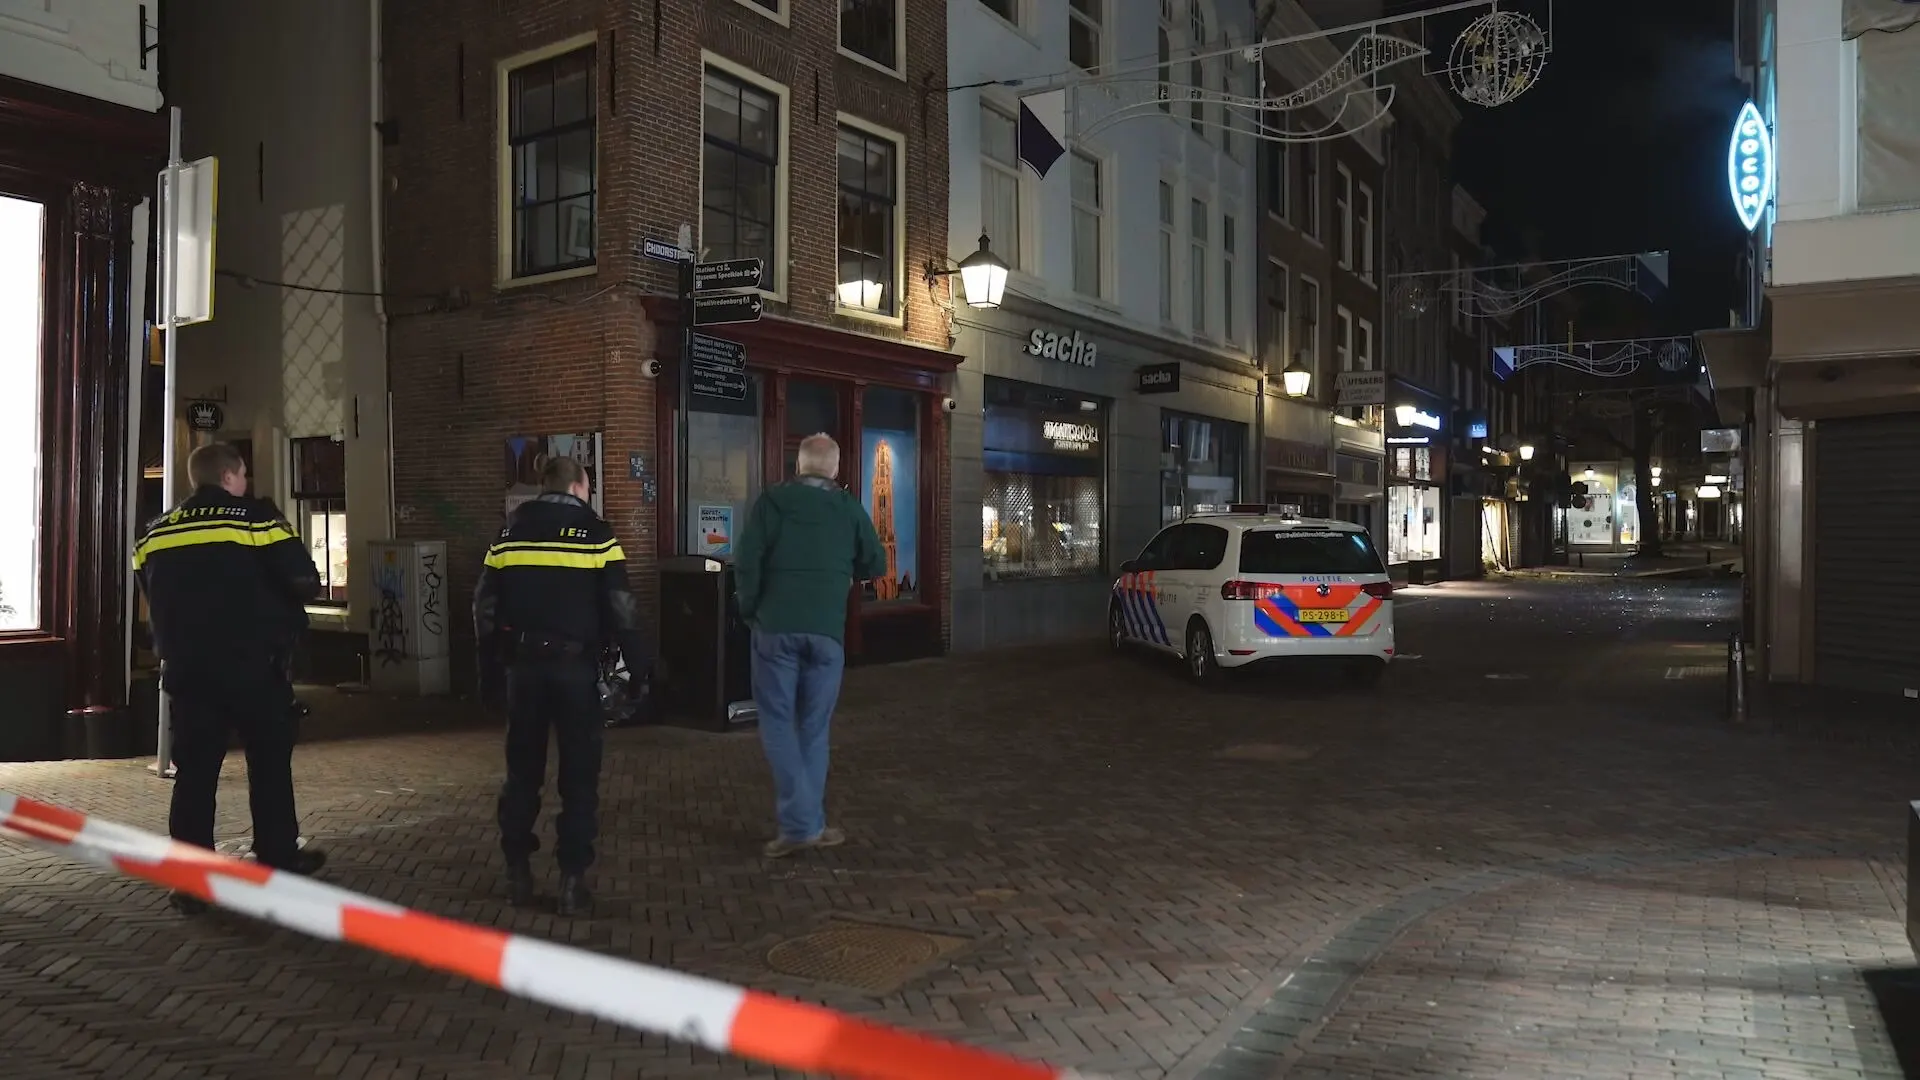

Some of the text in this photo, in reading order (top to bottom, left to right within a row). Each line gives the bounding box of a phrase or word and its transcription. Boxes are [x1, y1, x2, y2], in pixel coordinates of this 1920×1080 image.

[1029, 329, 1097, 368] sacha
[1141, 370, 1172, 385] sacha
[1302, 610, 1345, 620] PS-298-F
